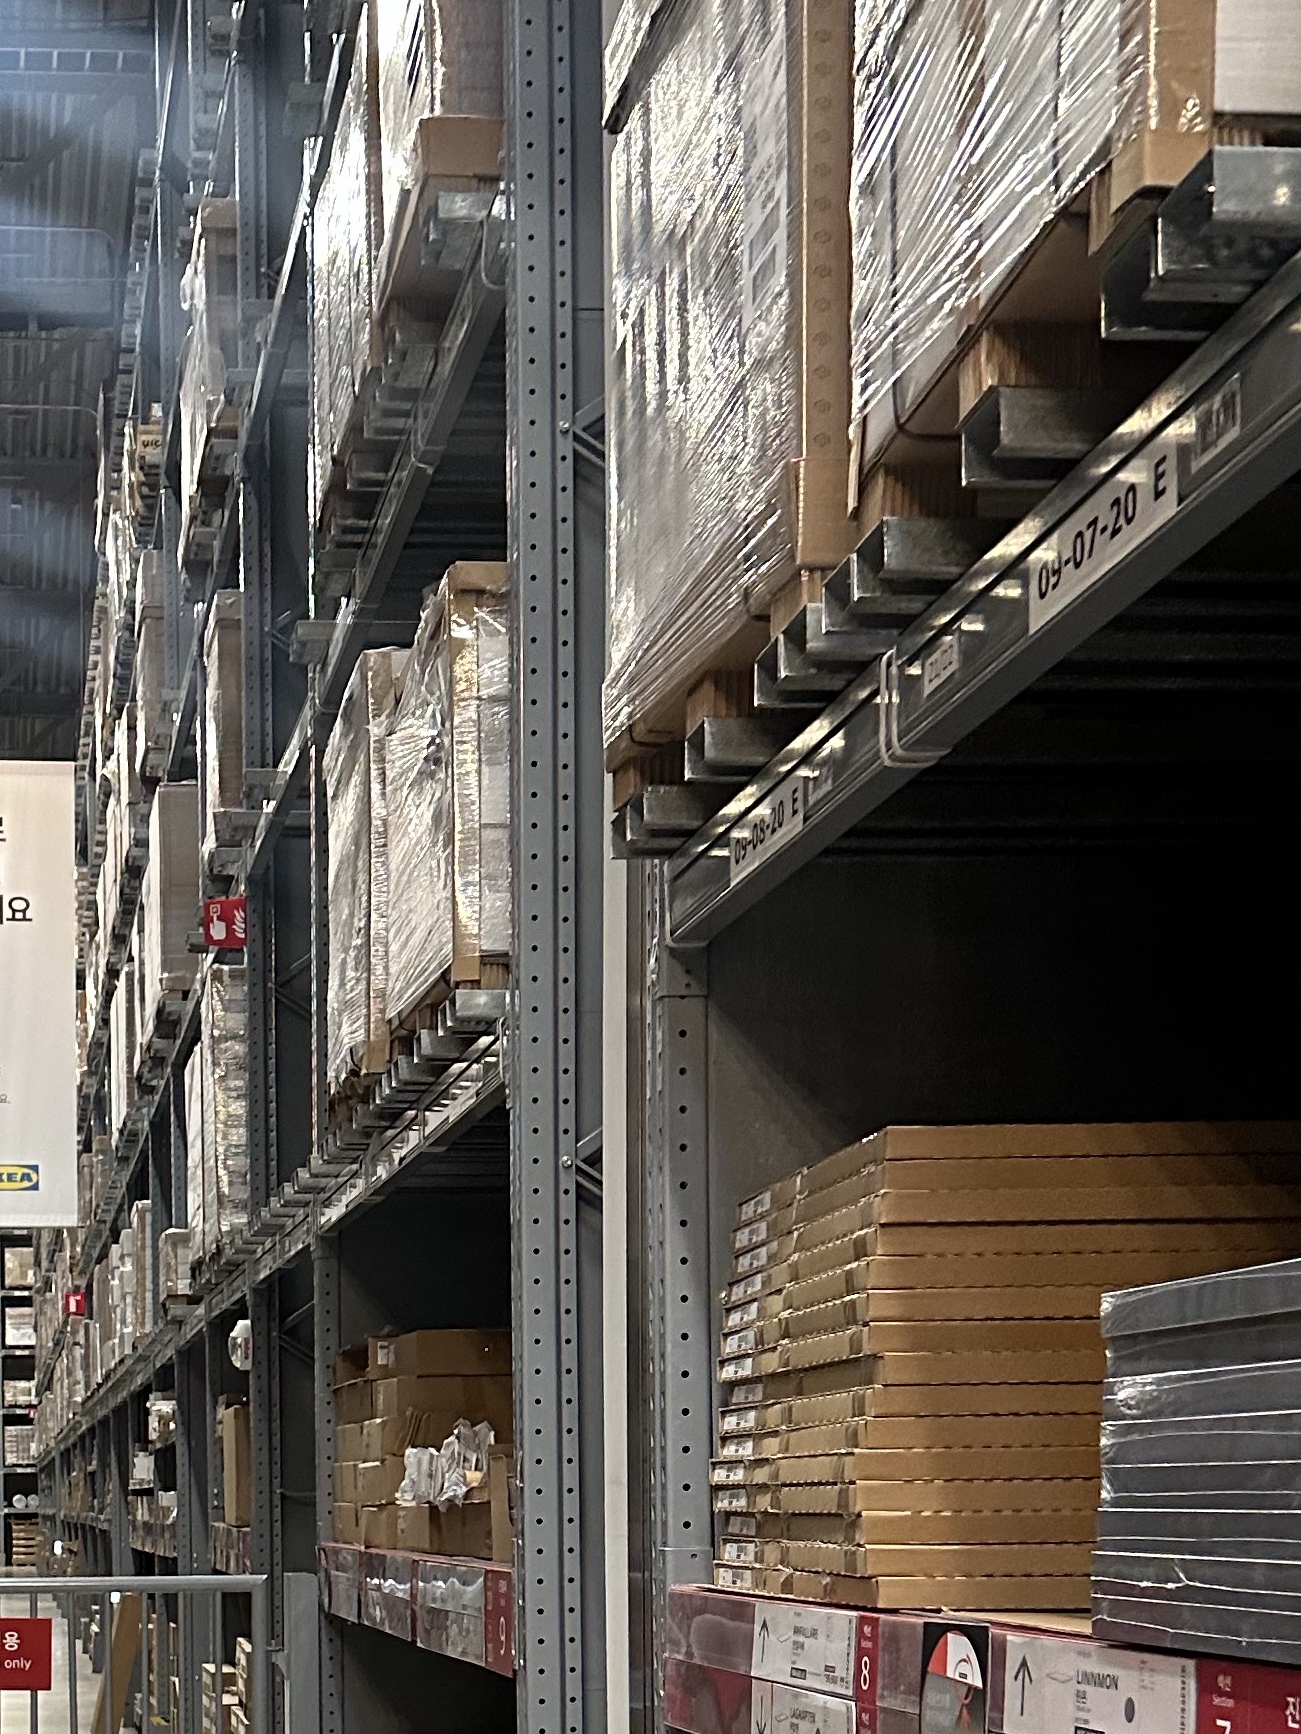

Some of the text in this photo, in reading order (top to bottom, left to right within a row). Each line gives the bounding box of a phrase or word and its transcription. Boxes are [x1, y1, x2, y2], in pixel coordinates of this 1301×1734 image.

[1037, 454, 1168, 600] 09-07-20 E
[734, 786, 799, 865] 09-08-20 E
[4, 1656, 32, 1671] only
[860, 1655, 870, 1691] 8
[1075, 1669, 1120, 1691] LINNMON
